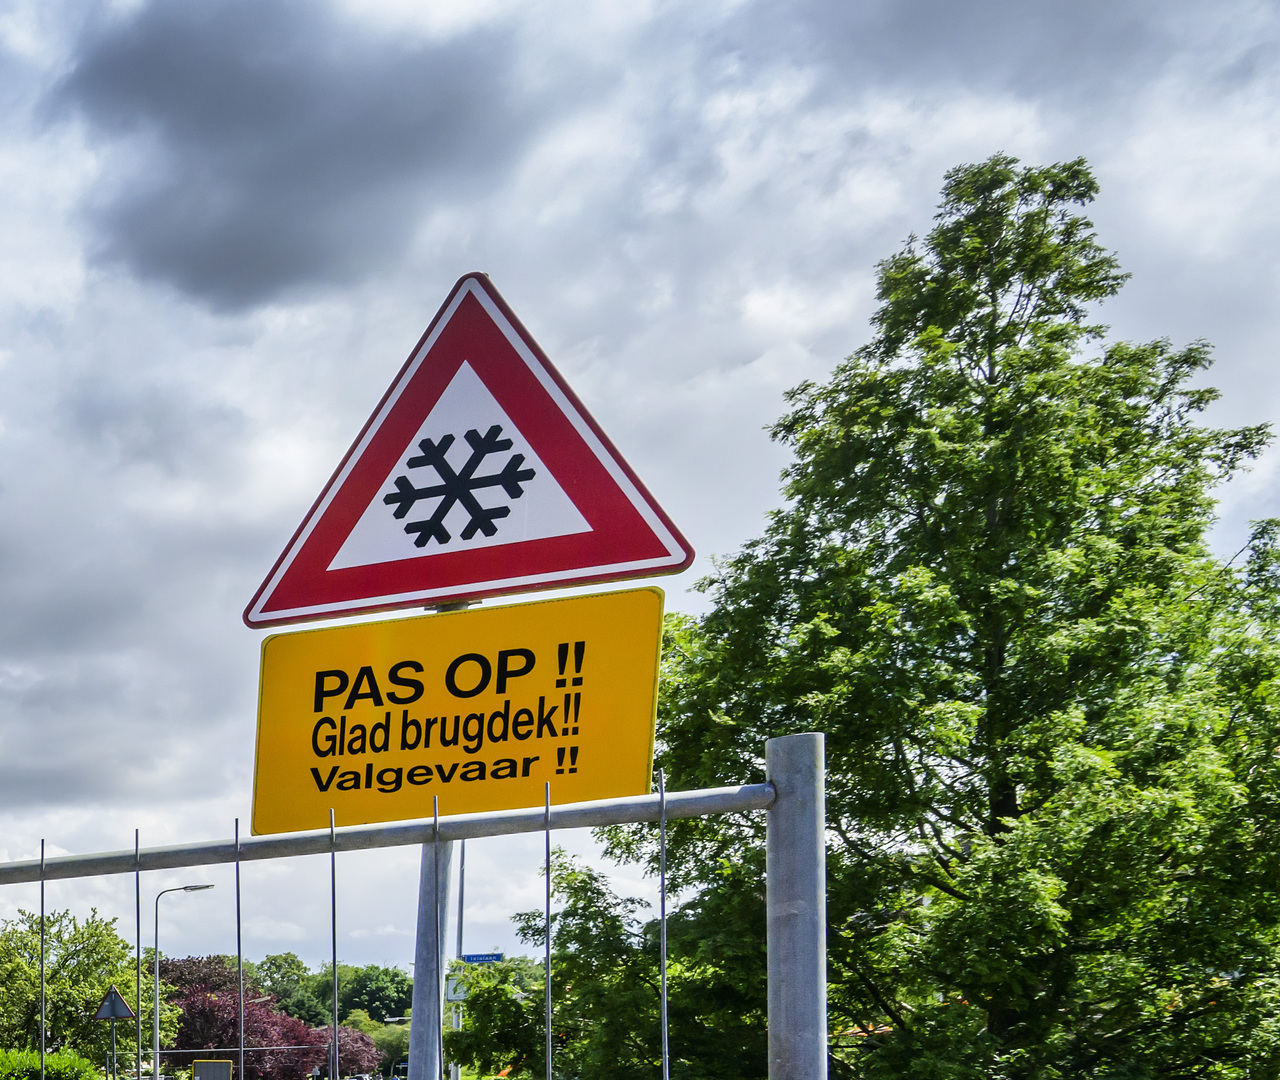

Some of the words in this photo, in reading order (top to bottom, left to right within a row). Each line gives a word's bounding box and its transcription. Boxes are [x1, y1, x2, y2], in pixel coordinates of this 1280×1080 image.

[313, 660, 425, 713] PAS
[445, 648, 536, 699] OP
[555, 640, 586, 689] !!
[311, 711, 391, 758] Glad
[400, 692, 581, 754] brugdek!!
[310, 755, 540, 794] Valgevaar
[555, 745, 579, 775] !!
